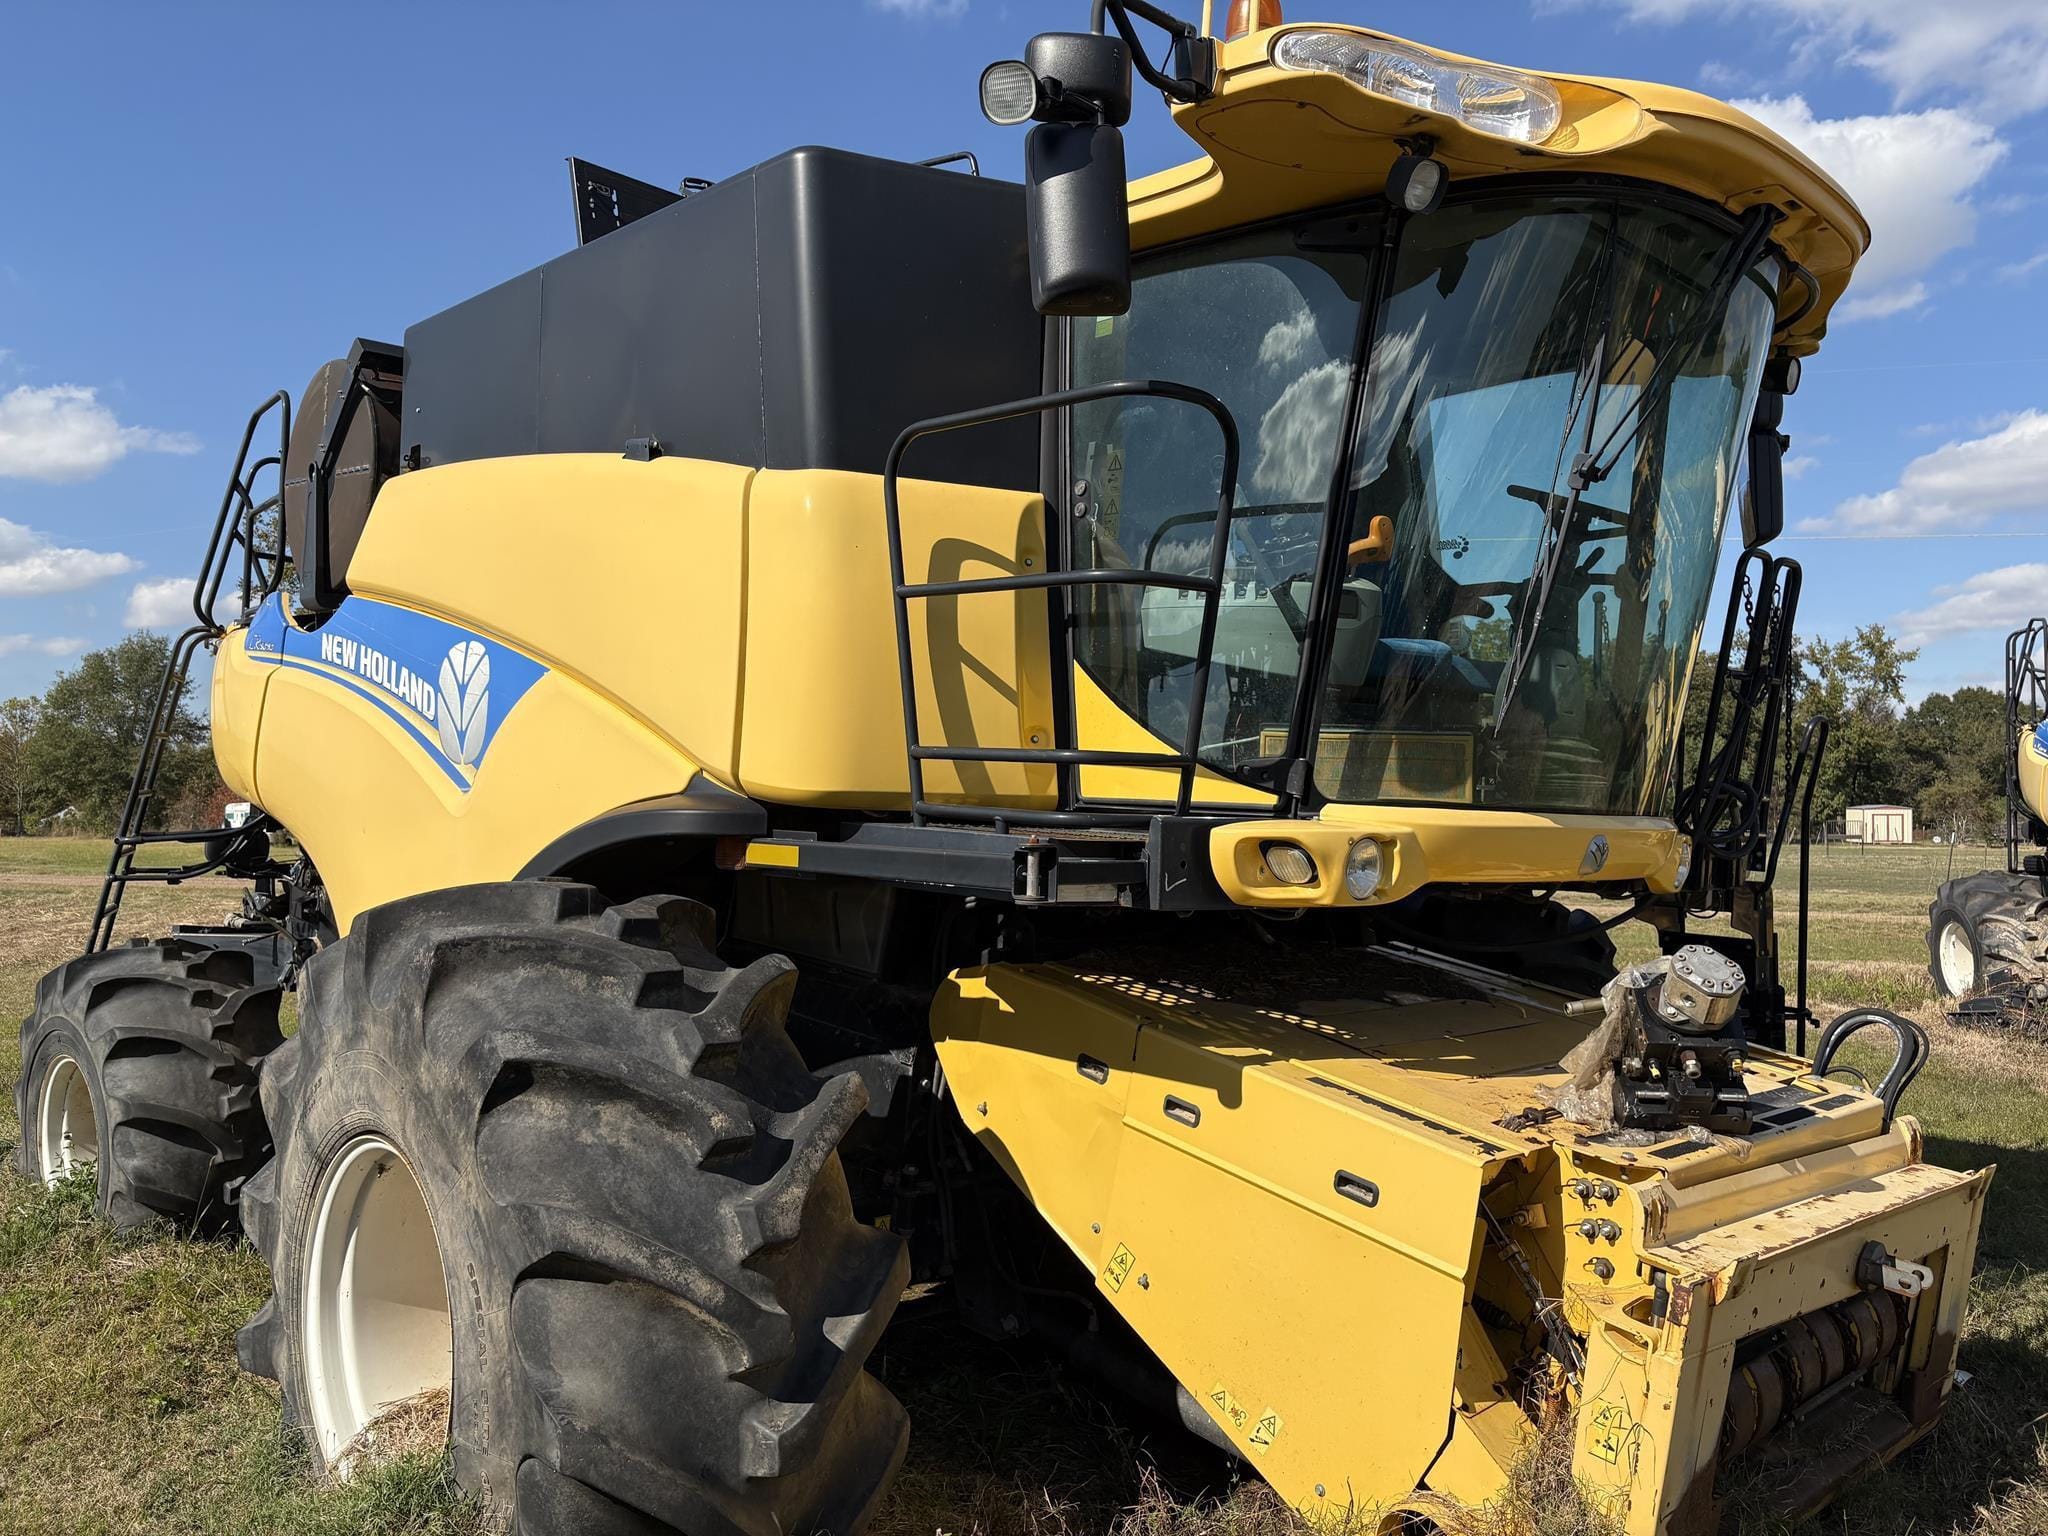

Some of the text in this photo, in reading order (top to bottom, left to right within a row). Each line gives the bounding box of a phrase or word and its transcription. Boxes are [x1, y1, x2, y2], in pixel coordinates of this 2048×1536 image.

[321, 632, 436, 721] NEW HOLLAND
[467, 1262, 488, 1374] SPECIAL
[480, 1389, 490, 1457] SURE
